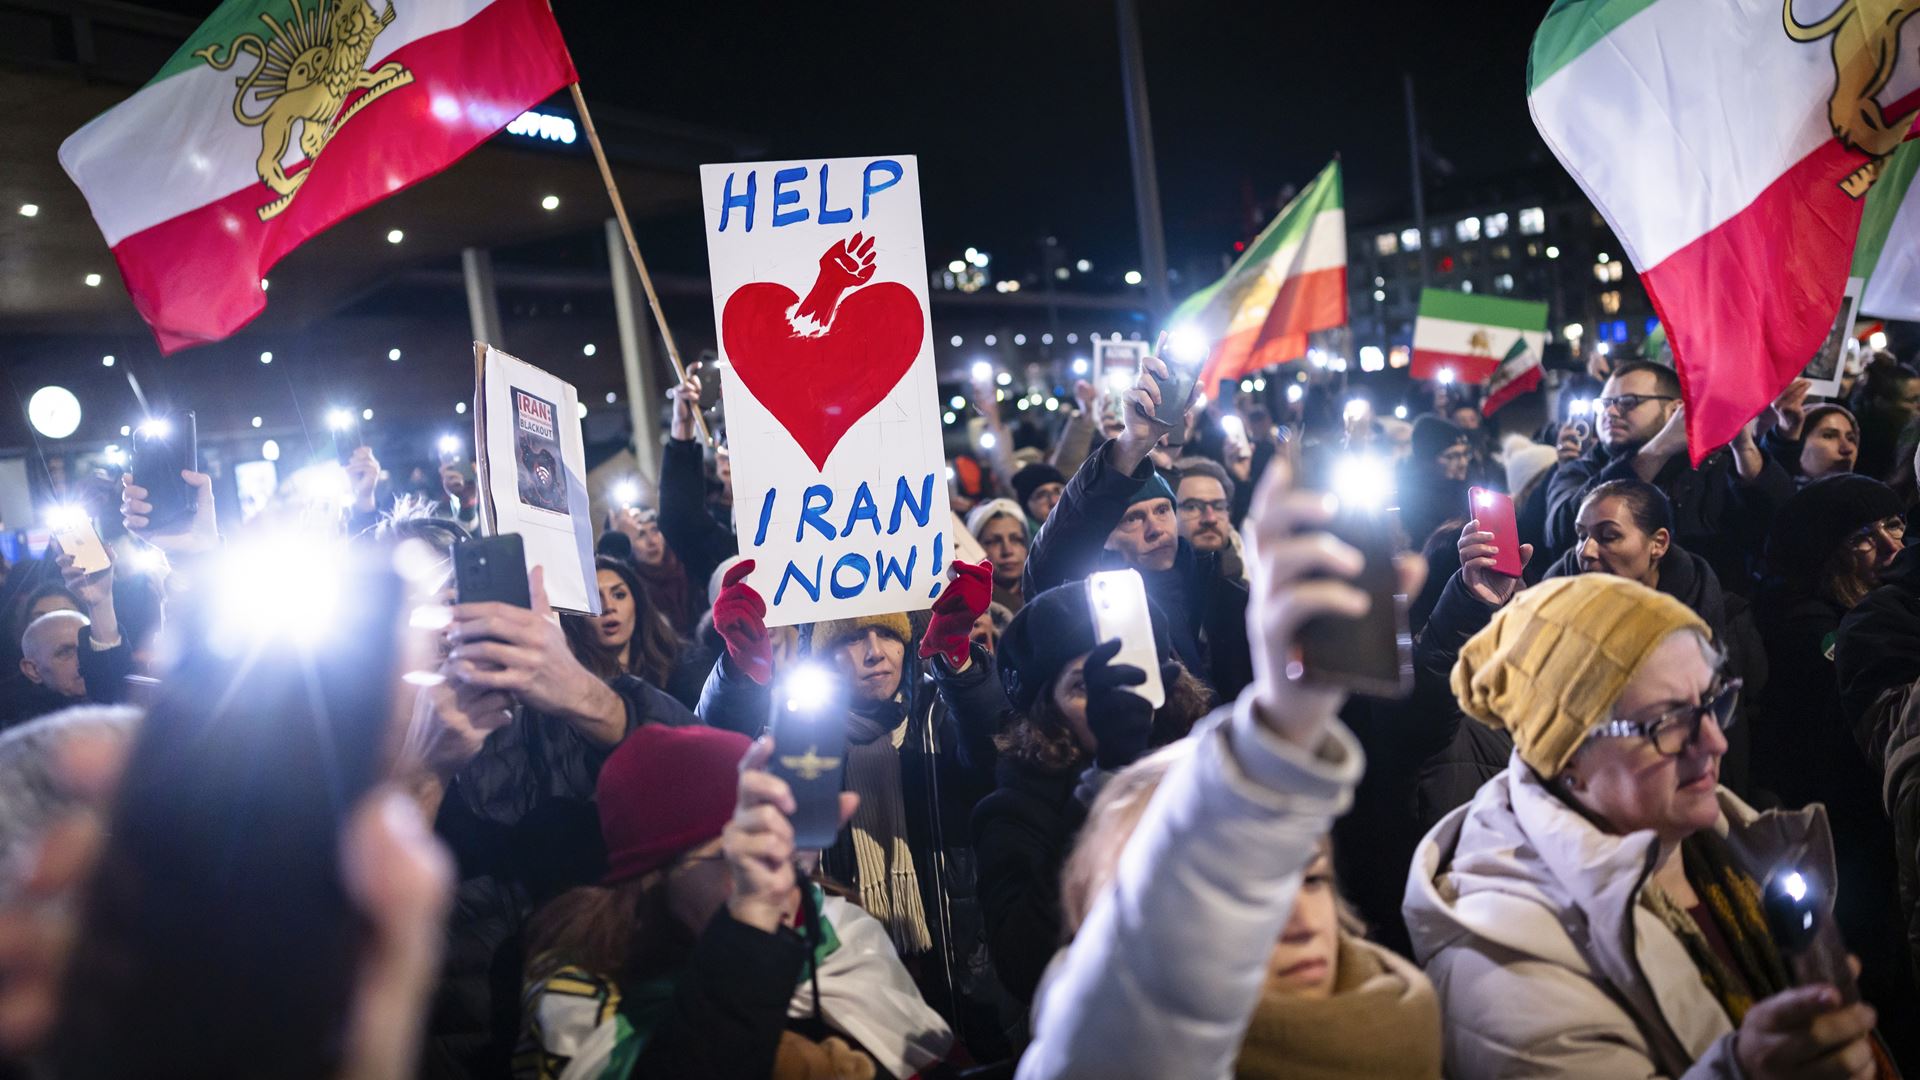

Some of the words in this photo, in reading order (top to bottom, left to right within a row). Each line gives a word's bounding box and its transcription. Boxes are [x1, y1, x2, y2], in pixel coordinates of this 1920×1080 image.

[719, 159, 904, 233] HELP
[518, 393, 551, 422] IRAN:
[520, 418, 553, 438] BLACKOUT
[753, 473, 935, 547] IRAN
[773, 532, 943, 606] NOW!
